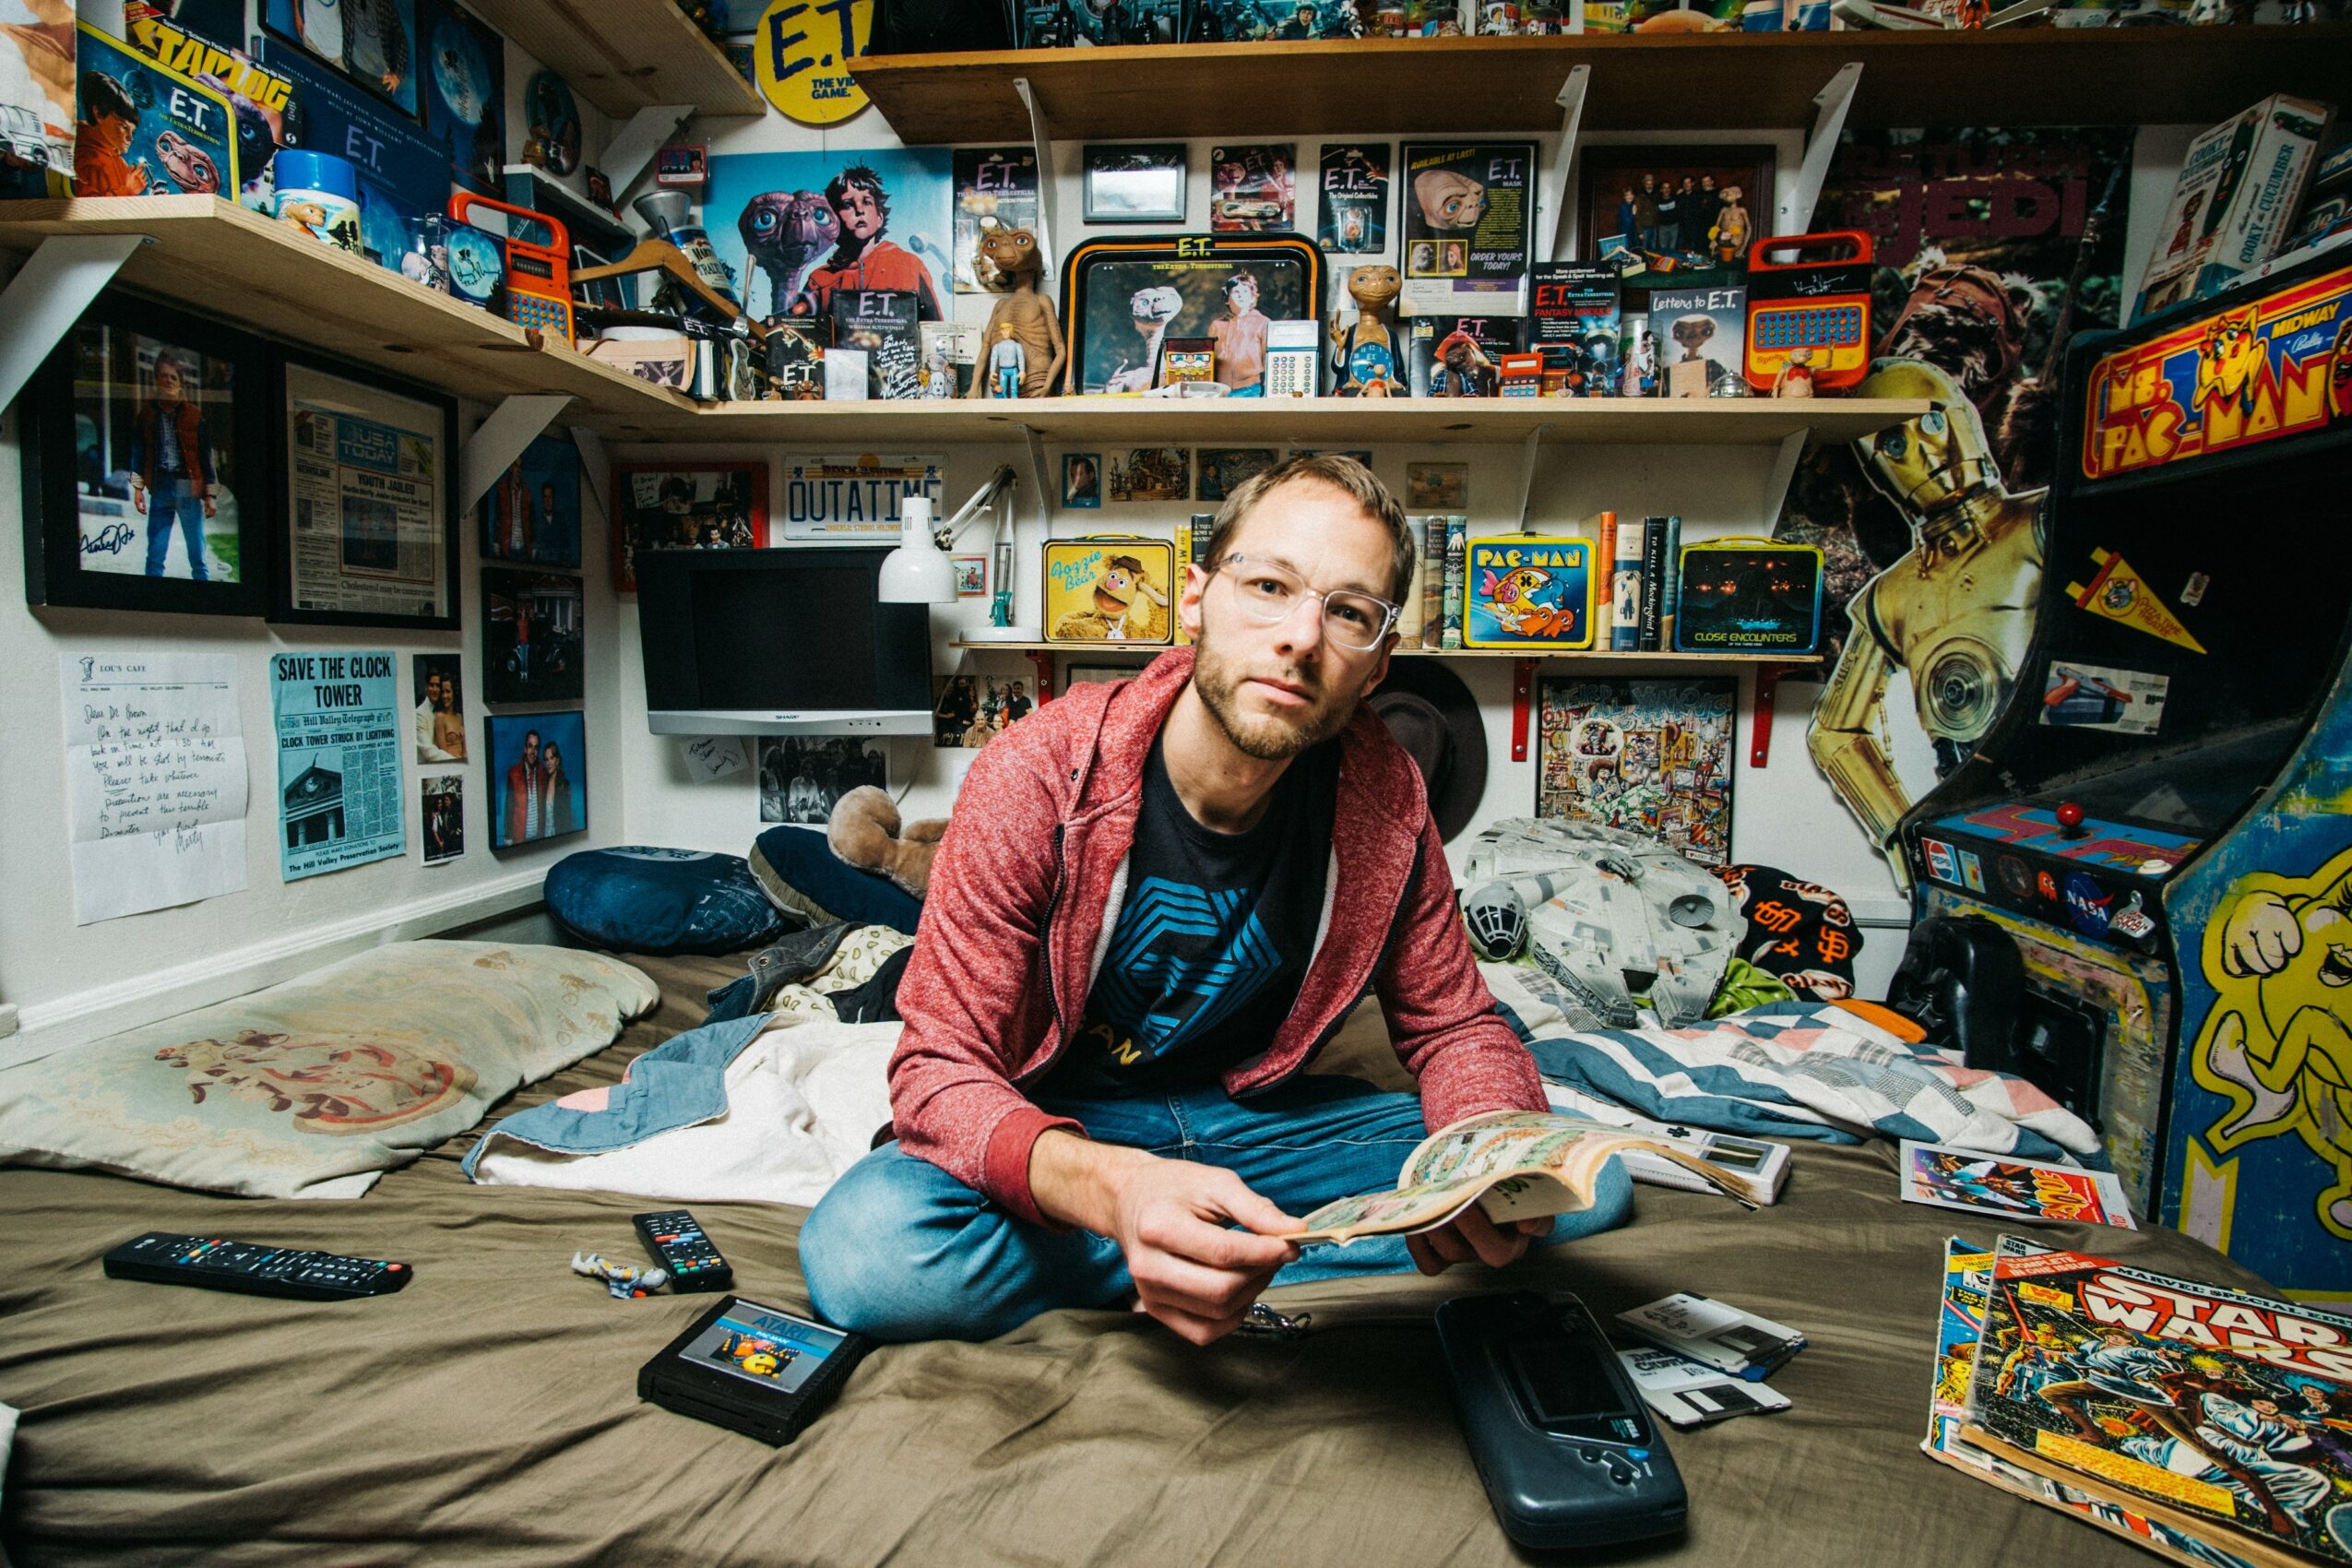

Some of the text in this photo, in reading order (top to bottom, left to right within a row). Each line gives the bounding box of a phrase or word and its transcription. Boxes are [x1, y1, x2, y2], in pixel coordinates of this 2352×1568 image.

[768, 0, 869, 82] E.T.
[132, 18, 292, 112] STARLOG
[812, 78, 834, 89] THE
[812, 88, 850, 100] GAME.
[171, 87, 210, 131] E.T.
[315, 82, 341, 101] MICHAEL
[343, 99, 369, 117] JACKSON
[355, 115, 371, 128] JOHN
[374, 125, 402, 145] WILLIAMS
[346, 124, 386, 173] E.T.
[1411, 148, 1476, 171] AVAILABLE AT LAST!
[1246, 152, 1266, 172] E.T.
[1488, 158, 1522, 181] E.T.
[977, 162, 1019, 190] E.T.
[1324, 167, 1360, 191] E.T.
[1338, 192, 1354, 200] Original
[2239, 144, 2296, 264] COOKY CUCUMBER
[1873, 179, 2087, 267] JEDI
[1178, 237, 1212, 258] E.T.
[1470, 253, 1523, 262] ORDER YOURS
[1483, 261, 1510, 270] TODAY!
[859, 291, 898, 317] E.T.
[1536, 284, 1572, 307] E.T.
[1653, 290, 1743, 312] Letters to E.T.
[1535, 307, 1612, 316] FANTASY MODULE
[2271, 302, 2342, 339] MIDWAY
[683, 320, 708, 337] E.T.
[1456, 318, 1488, 338] E.T.
[2291, 334, 2323, 354] Bally
[2108, 366, 2168, 414] MS.
[2101, 362, 2328, 471] PAC-MAN
[359, 428, 395, 449] USA
[340, 439, 396, 464] TODAY
[357, 473, 415, 495] YOUTH JAILED
[1651, 535, 1658, 546] TO
[1051, 550, 1103, 579] Fozzie
[1178, 549, 1188, 582] MICE
[1477, 549, 1581, 568] PAC-MAN
[380, 585, 392, 595] may
[394, 587, 401, 595] be
[1064, 570, 1097, 591] Bear
[1643, 580, 1658, 632] Mockingbird
[1694, 633, 1798, 643] CLOSE ENCOUNTERS
[279, 656, 392, 681] SAVE THE CLOCK
[314, 684, 362, 708] TOWER
[1549, 683, 1612, 712] WEIRD
[84, 704, 148, 724] Dear Brown
[303, 712, 375, 728] Hill Valley Telegraph
[97, 719, 210, 742] On the night that go
[281, 729, 395, 748] CLOCK TOWER STRUCK BY LIGHTNING
[123, 740, 145, 751] time
[117, 755, 132, 767] will
[139, 754, 148, 766] be
[177, 752, 186, 767] by
[103, 770, 199, 787] Please take whatever
[157, 789, 218, 801] are necessary
[99, 800, 209, 824] to prevent this terrible
[176, 830, 203, 854] Marty
[303, 861, 315, 870] Hill
[317, 857, 338, 867] Valley
[339, 849, 377, 861] Preservation
[379, 843, 399, 854] Society
[1930, 854, 1952, 868] PEPSI
[2067, 889, 2108, 922] NASA
[2002, 1244, 2026, 1256] WARS
[2005, 1240, 2026, 1251] STAR
[2007, 1256, 2076, 1269] COMPLETE
[2010, 1261, 2097, 1277] IN ONE ISSUE!
[2117, 1266, 2352, 1327] MARVEL SPECIAL EDIT
[2085, 1275, 2341, 1348] STAR
[753, 1315, 805, 1340] ATARI
[756, 1331, 790, 1344] PAC-MAN
[2085, 1293, 2352, 1381] WARS
[1623, 1419, 1640, 1438] SEGA
